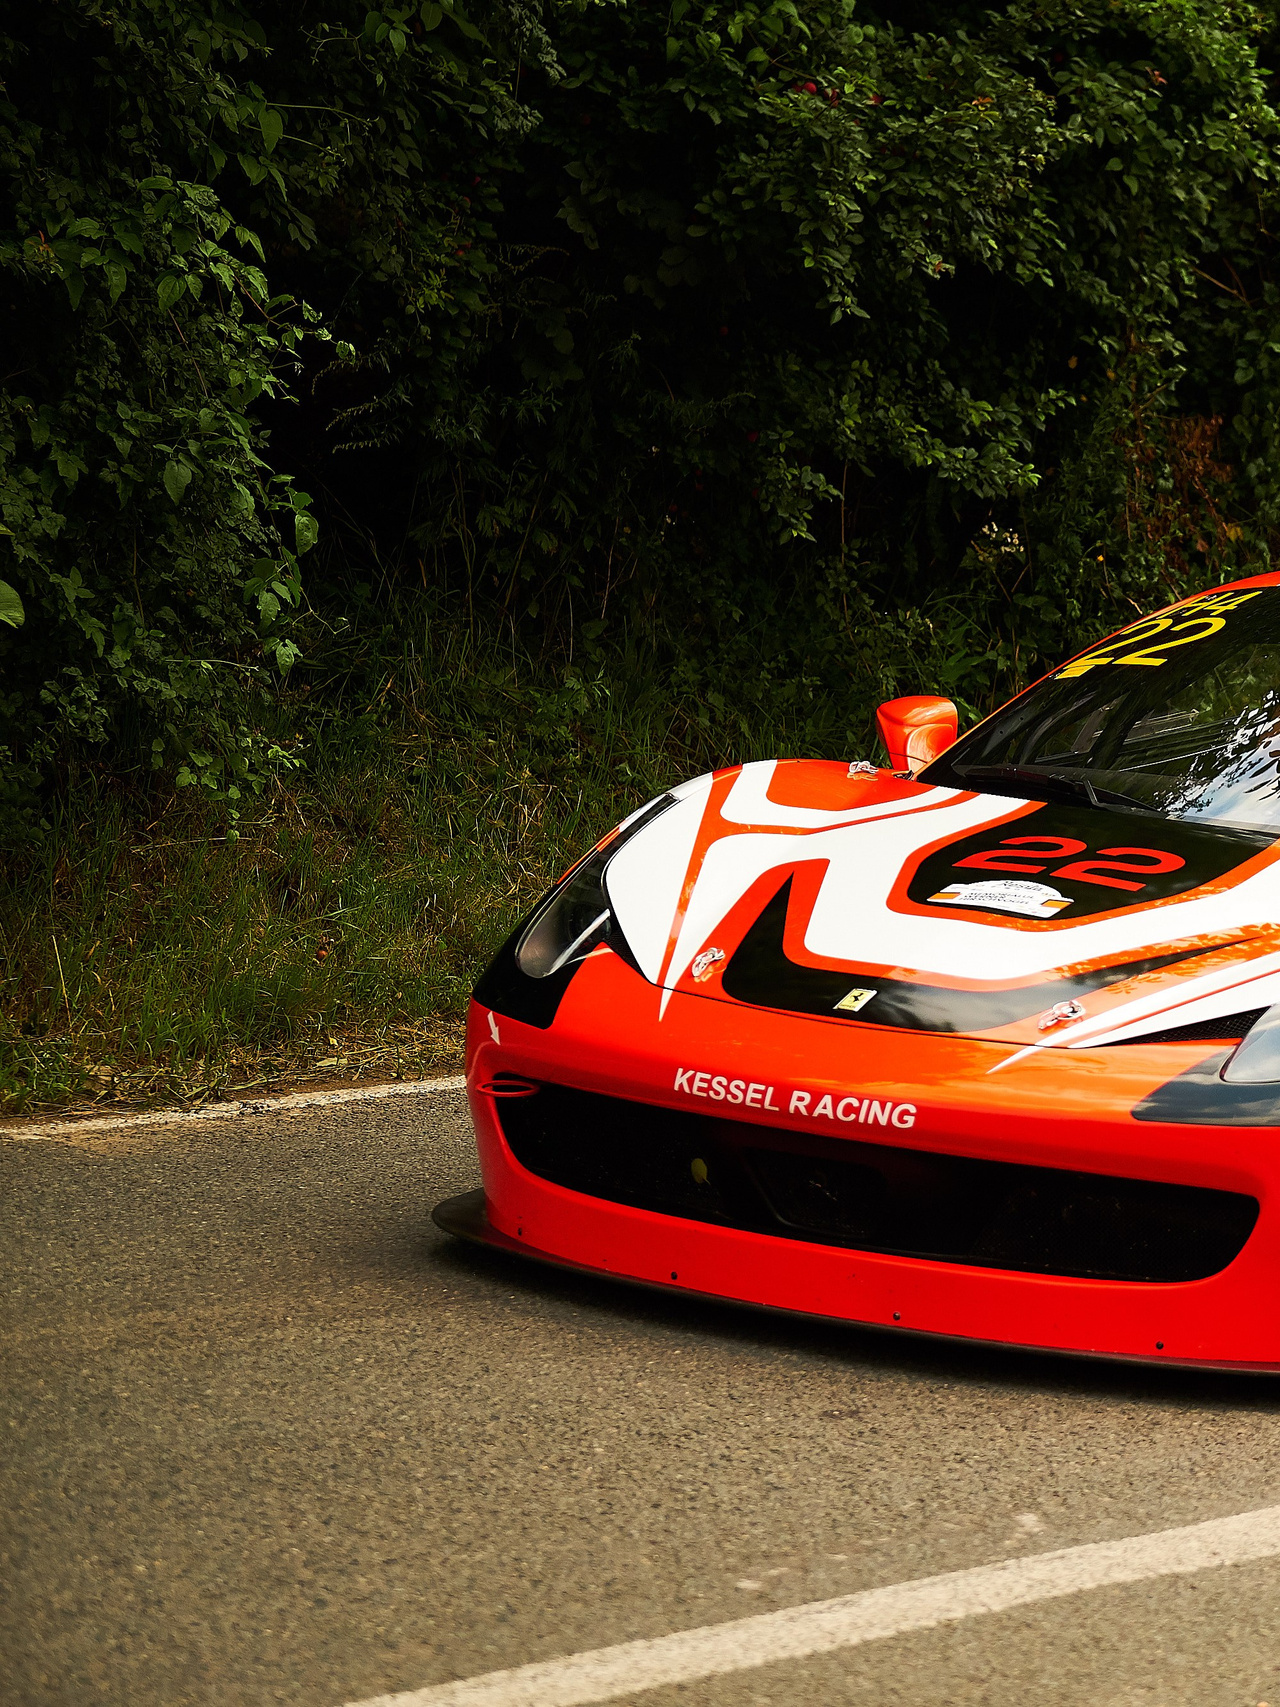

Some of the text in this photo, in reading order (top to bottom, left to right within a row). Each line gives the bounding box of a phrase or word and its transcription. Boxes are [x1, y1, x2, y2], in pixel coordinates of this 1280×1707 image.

[1062, 617, 1227, 669] 22
[951, 835, 1186, 892] 22
[673, 1067, 917, 1129] KESSEL RACING
